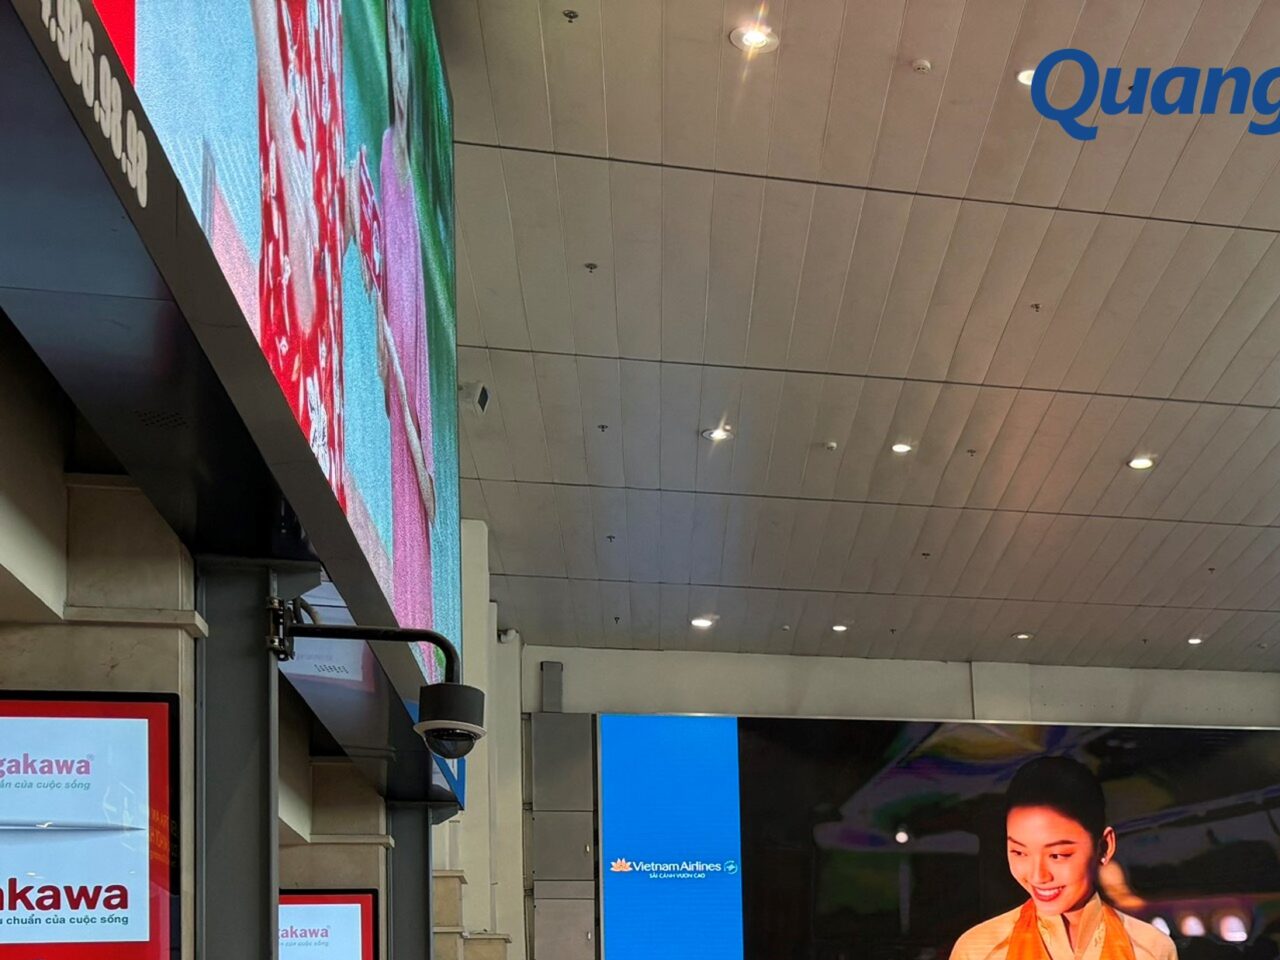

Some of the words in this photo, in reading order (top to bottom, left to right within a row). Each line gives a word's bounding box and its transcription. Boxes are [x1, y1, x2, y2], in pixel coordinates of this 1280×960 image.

[632, 861, 680, 872] Vietnam
[680, 861, 722, 872] Airlines
[6, 913, 42, 925] chuẩn
[45, 914, 66, 925] của
[69, 915, 97, 925] cuộc
[100, 913, 129, 926] sống
[278, 925, 329, 940] akawa
